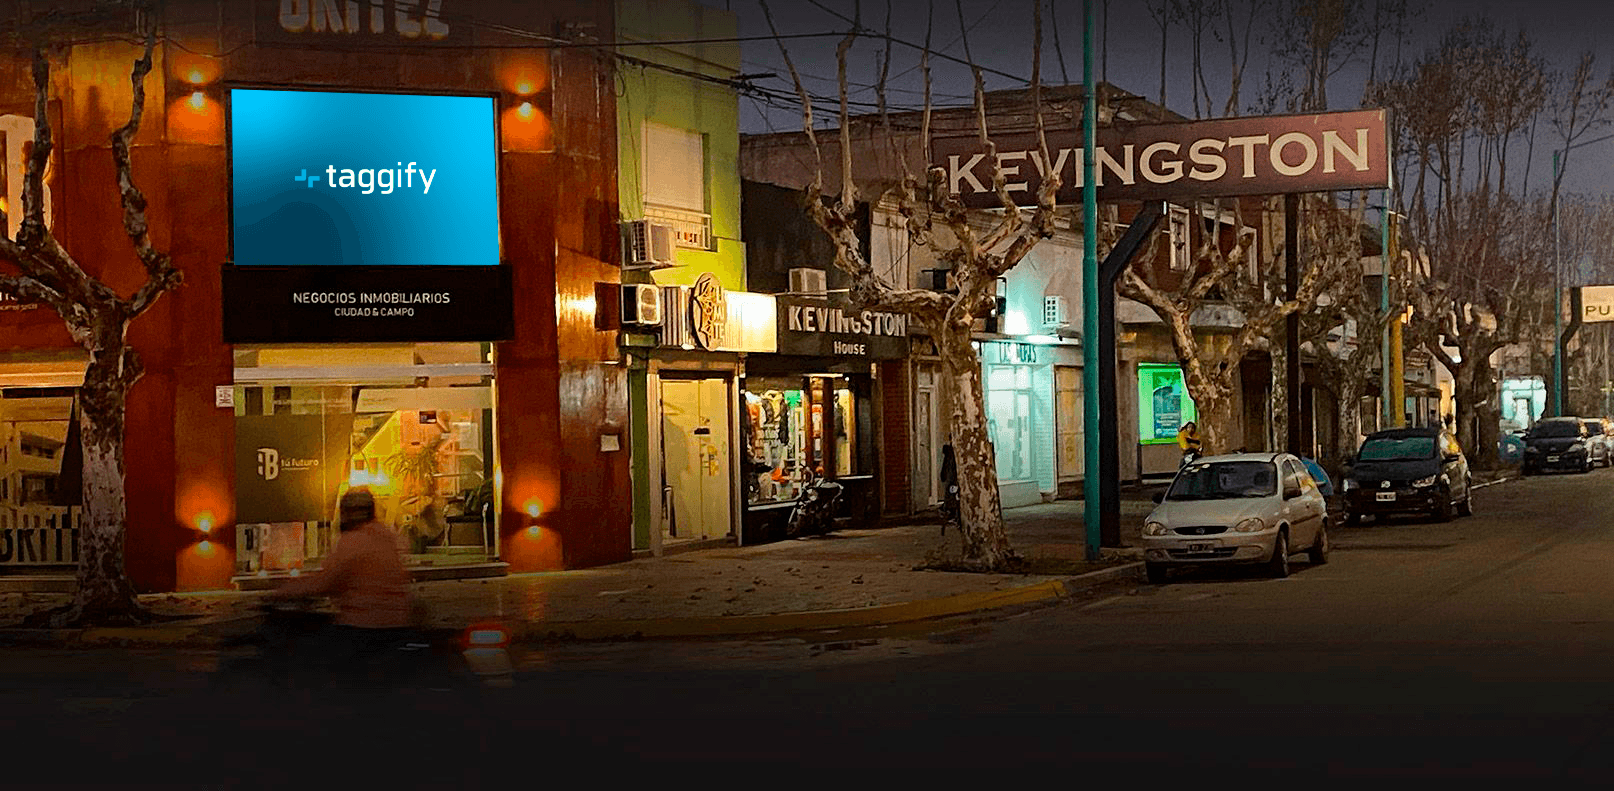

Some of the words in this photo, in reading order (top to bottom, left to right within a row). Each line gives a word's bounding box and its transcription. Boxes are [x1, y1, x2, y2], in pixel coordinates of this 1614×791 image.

[948, 128, 1370, 194] KEVINGSTON
[326, 162, 437, 195] taggify
[293, 292, 357, 304] NEGOCIOS
[360, 292, 451, 304] INMOBILIARIOS
[334, 307, 371, 317] CIUDAD
[372, 307, 379, 317] &
[380, 307, 415, 317] CAMPO
